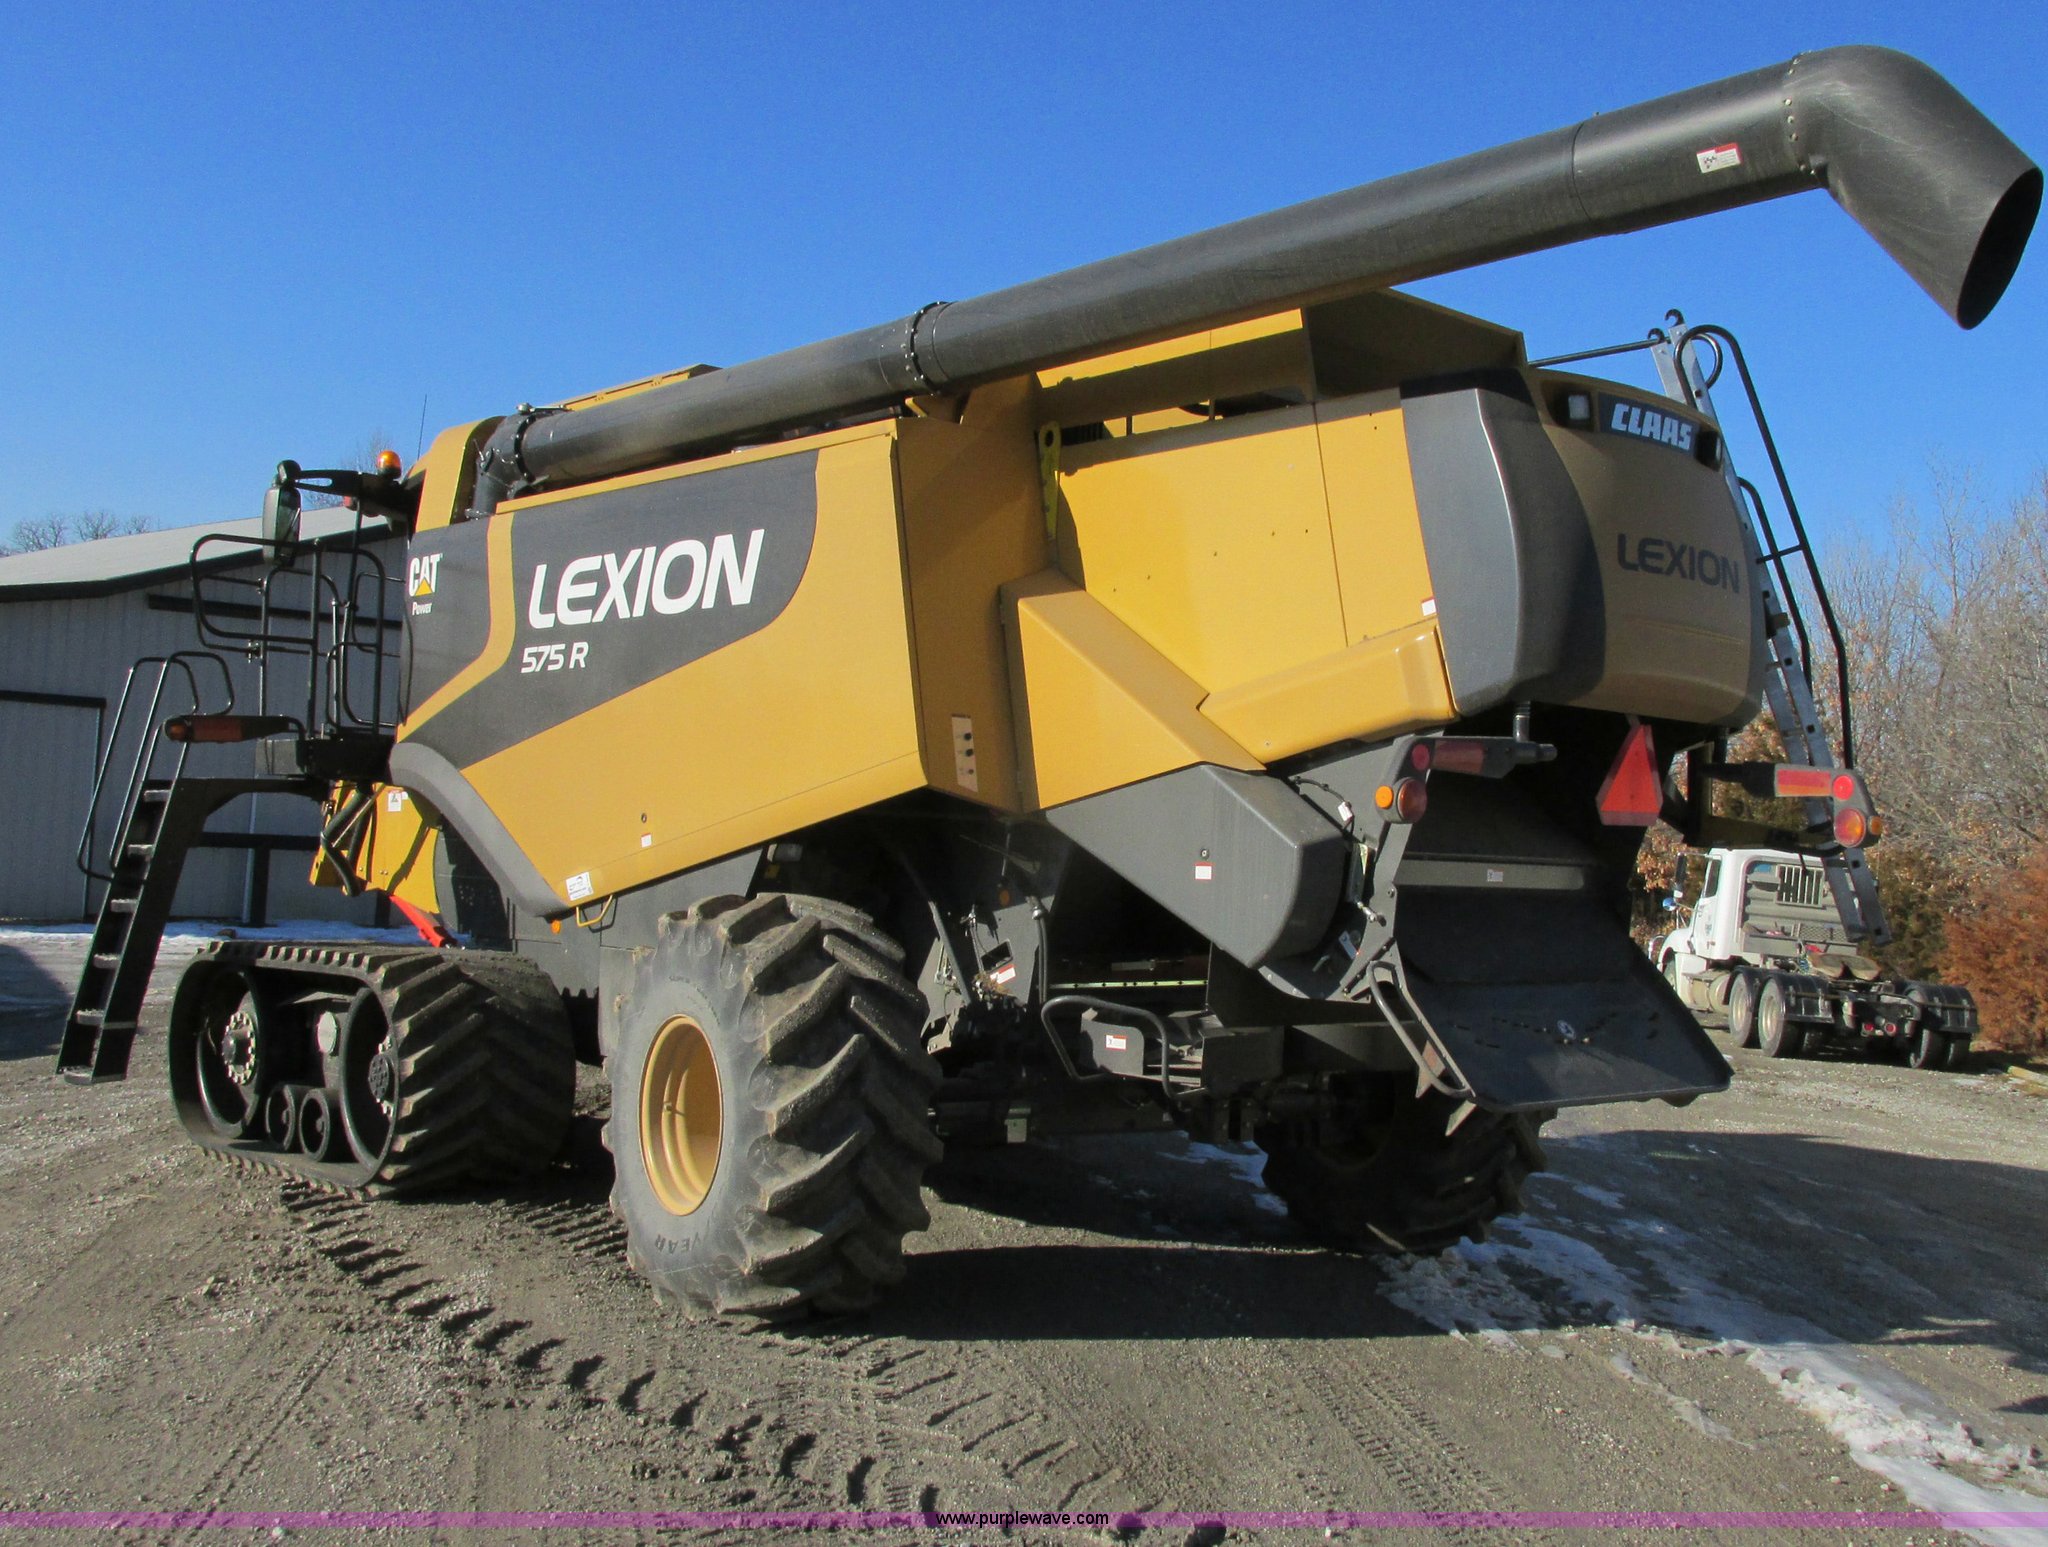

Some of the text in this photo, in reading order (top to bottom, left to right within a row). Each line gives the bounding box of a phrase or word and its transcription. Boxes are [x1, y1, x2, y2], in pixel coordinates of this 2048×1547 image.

[1611, 403, 1693, 451] CLAAS
[409, 553, 441, 597] CAT
[529, 528, 765, 629] LEXION
[1617, 533, 1740, 594] LEXION
[411, 601, 433, 616] Power
[521, 641, 589, 673] 575 R
